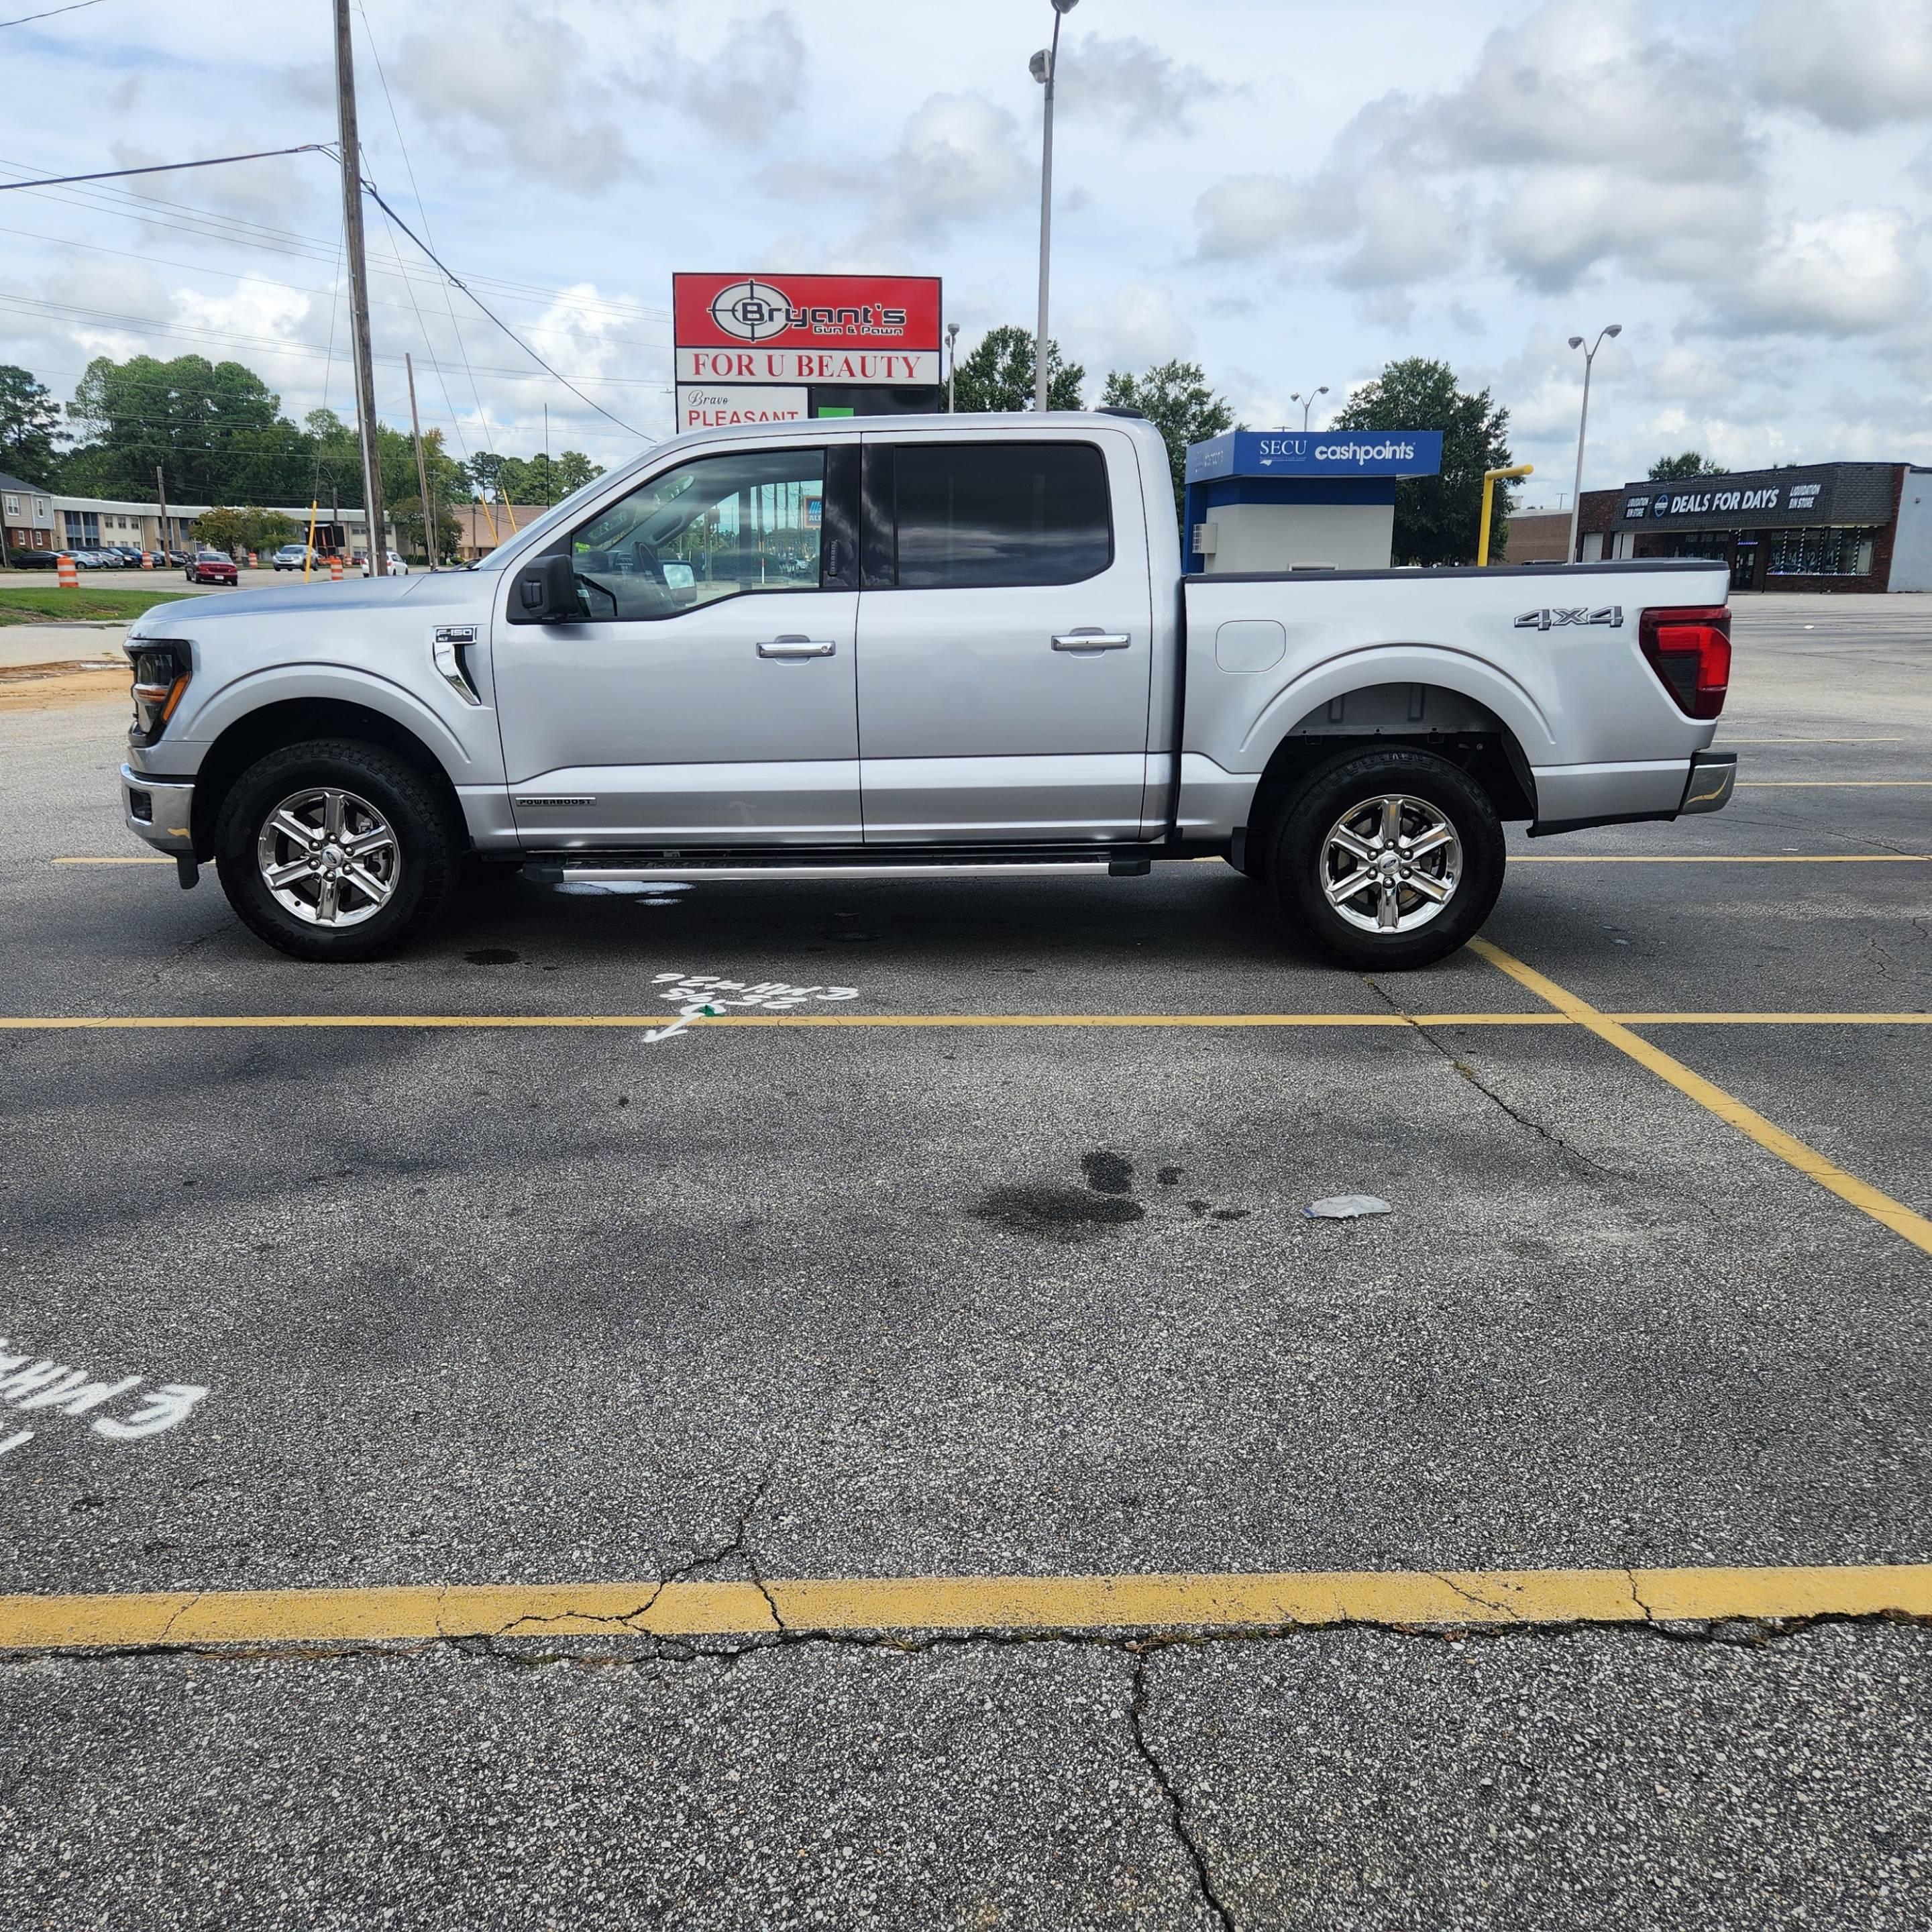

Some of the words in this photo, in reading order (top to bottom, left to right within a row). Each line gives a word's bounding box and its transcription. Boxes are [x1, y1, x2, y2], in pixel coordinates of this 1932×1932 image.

[741, 302, 906, 328] Bryant's
[813, 325, 842, 334] Gun
[847, 326, 857, 334] &
[861, 326, 904, 335] Pawn
[692, 354, 757, 376] FOR
[765, 354, 786, 377] U
[796, 355, 922, 379] BEAUTY
[688, 390, 730, 407] Bravo
[1260, 440, 1307, 455] SECU
[1315, 440, 1414, 466] cashpoints
[1790, 484, 1821, 496] LIQUIDATION
[1670, 494, 1711, 514] DEALS
[1712, 492, 1741, 511] FOR
[1788, 497, 1799, 509] BIN
[1797, 496, 1815, 508] STORE
